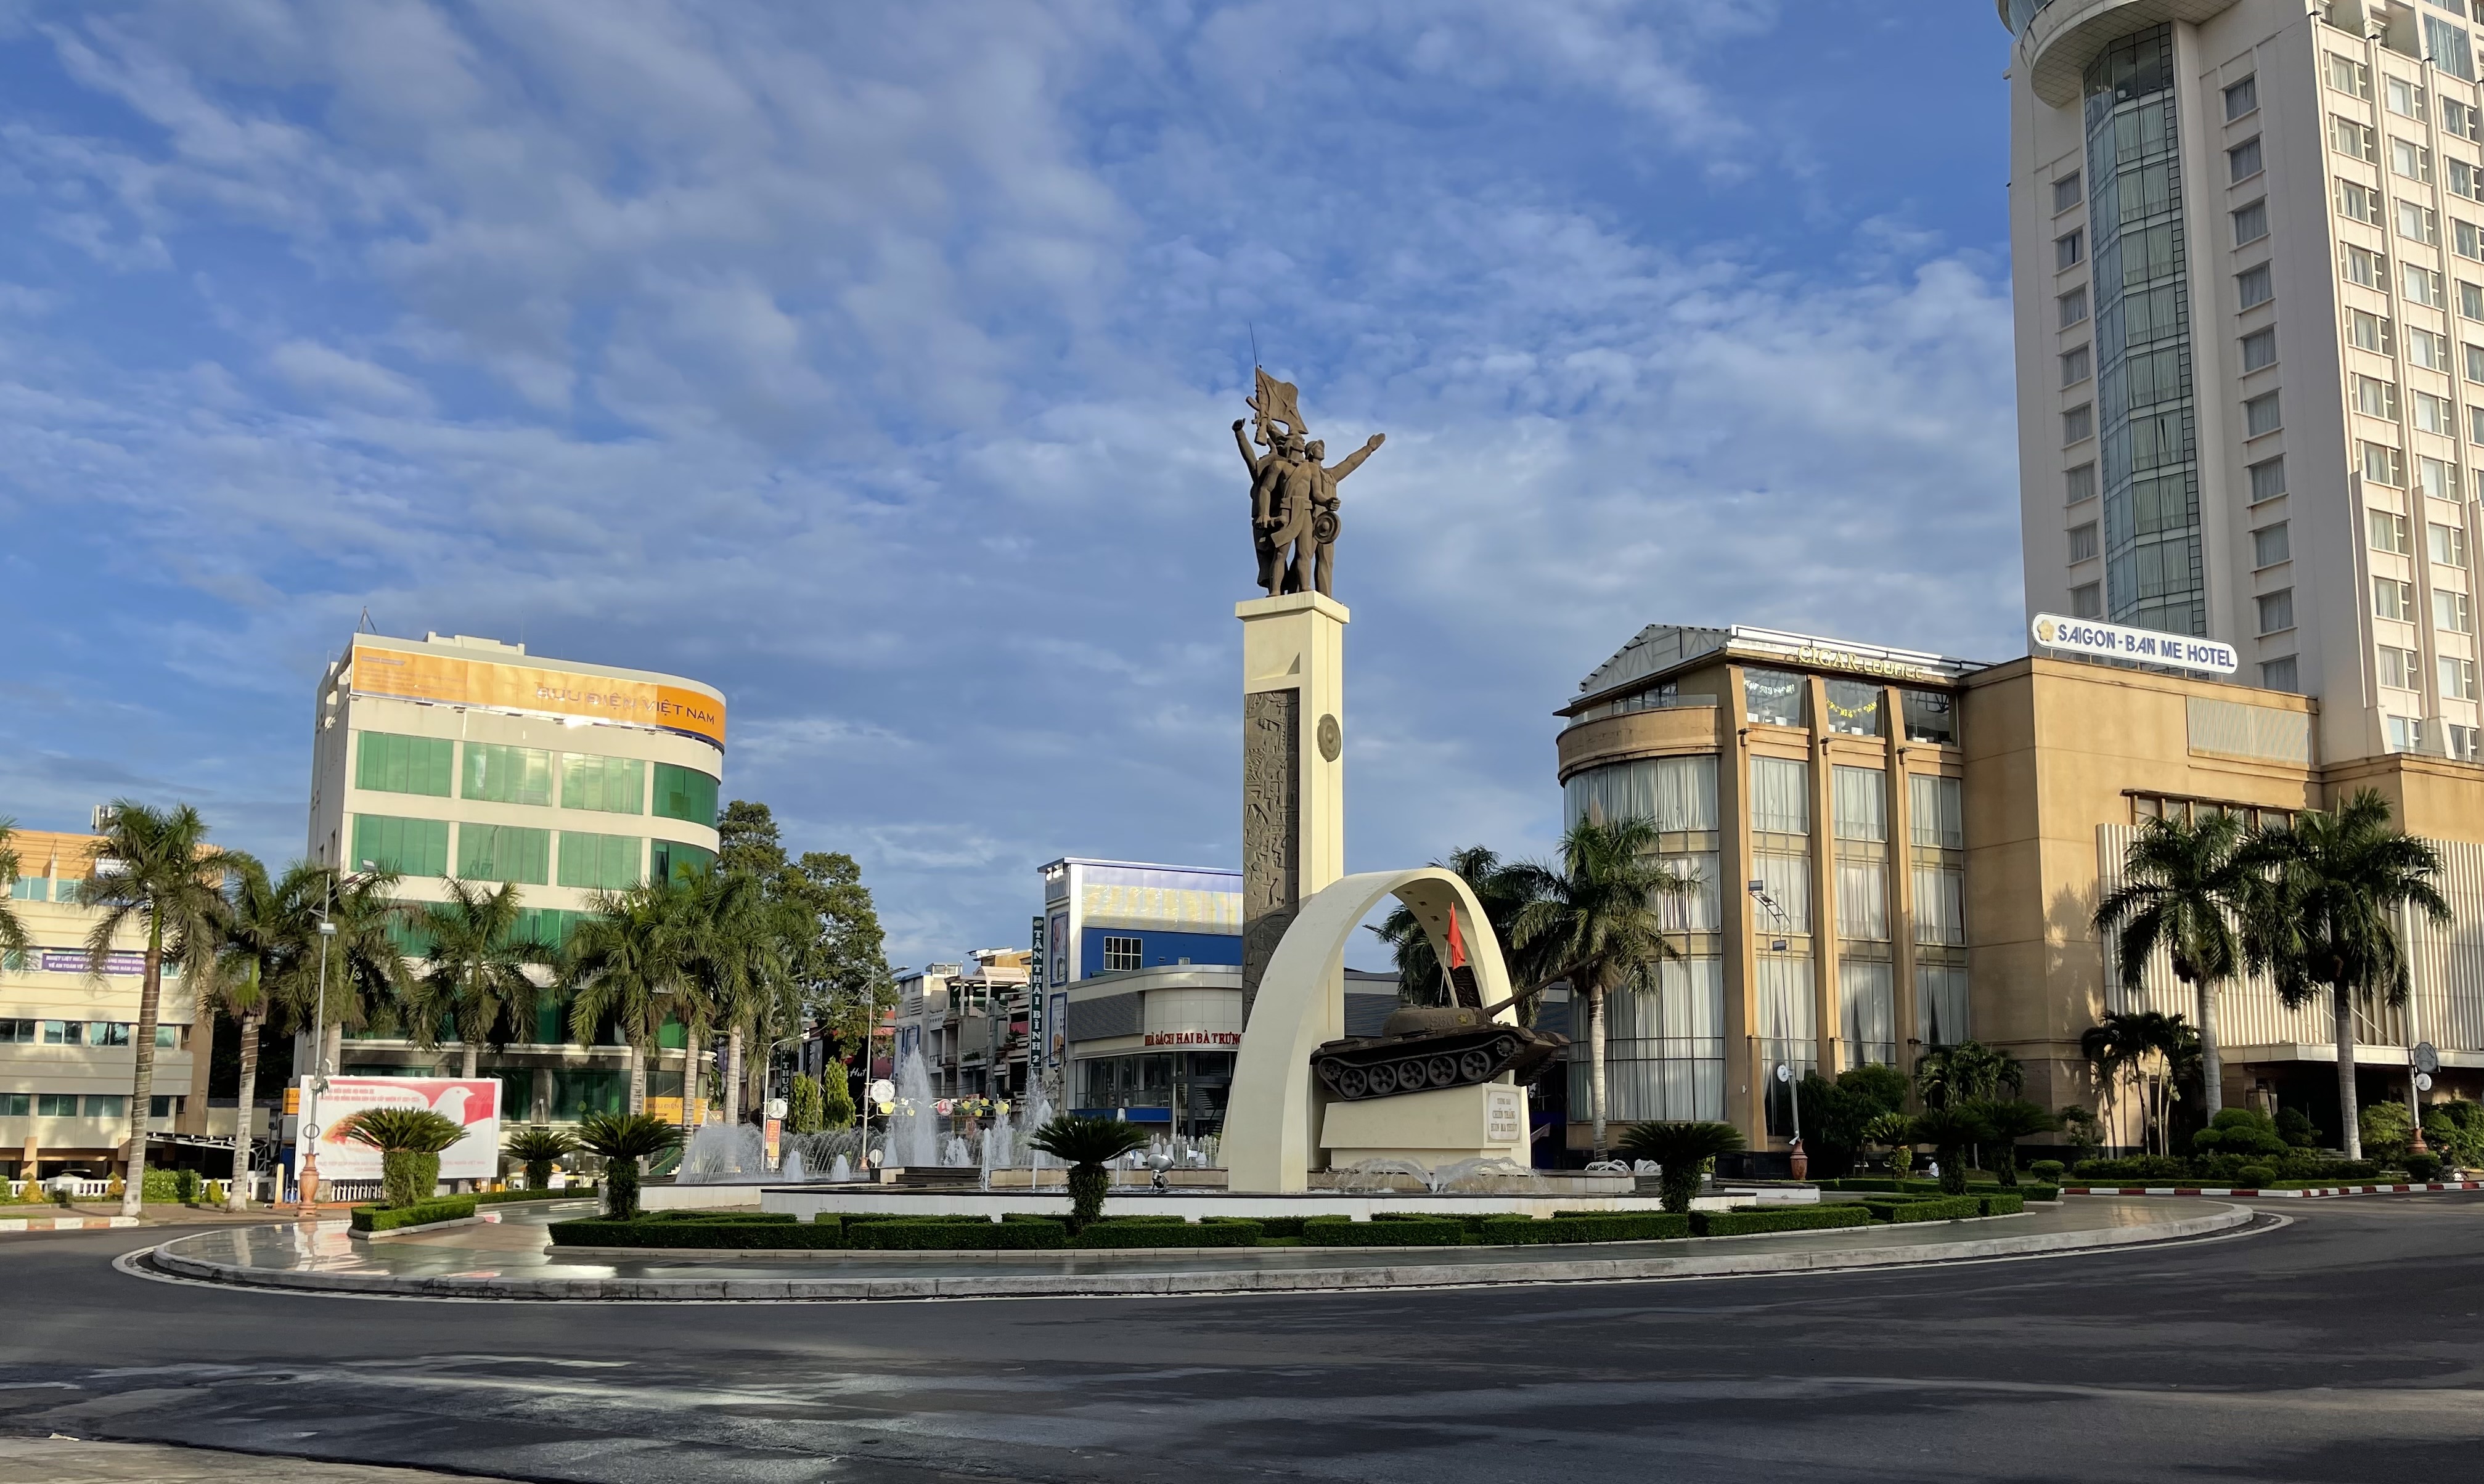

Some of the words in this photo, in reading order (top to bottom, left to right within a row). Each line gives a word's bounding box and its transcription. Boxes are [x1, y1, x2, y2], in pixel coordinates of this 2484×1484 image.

[1798, 646, 1858, 671] CIGAR
[2160, 640, 2182, 659] ME
[2188, 644, 2235, 668] HOTEL
[587, 692, 637, 710] ĐIỆN
[642, 698, 683, 716] VIỆT
[686, 707, 715, 725] NAM
[1033, 930, 1044, 960] TÂN
[1032, 964, 1043, 1005] THÁI
[1032, 1010, 1042, 1050] BÌNH
[1431, 1016, 1455, 1027] 980
[1156, 1030, 1175, 1045] SÁCH
[1176, 1032, 1195, 1044] HAI
[1196, 1029, 1211, 1044] BÀ
[850, 1067, 867, 1077] Hut
